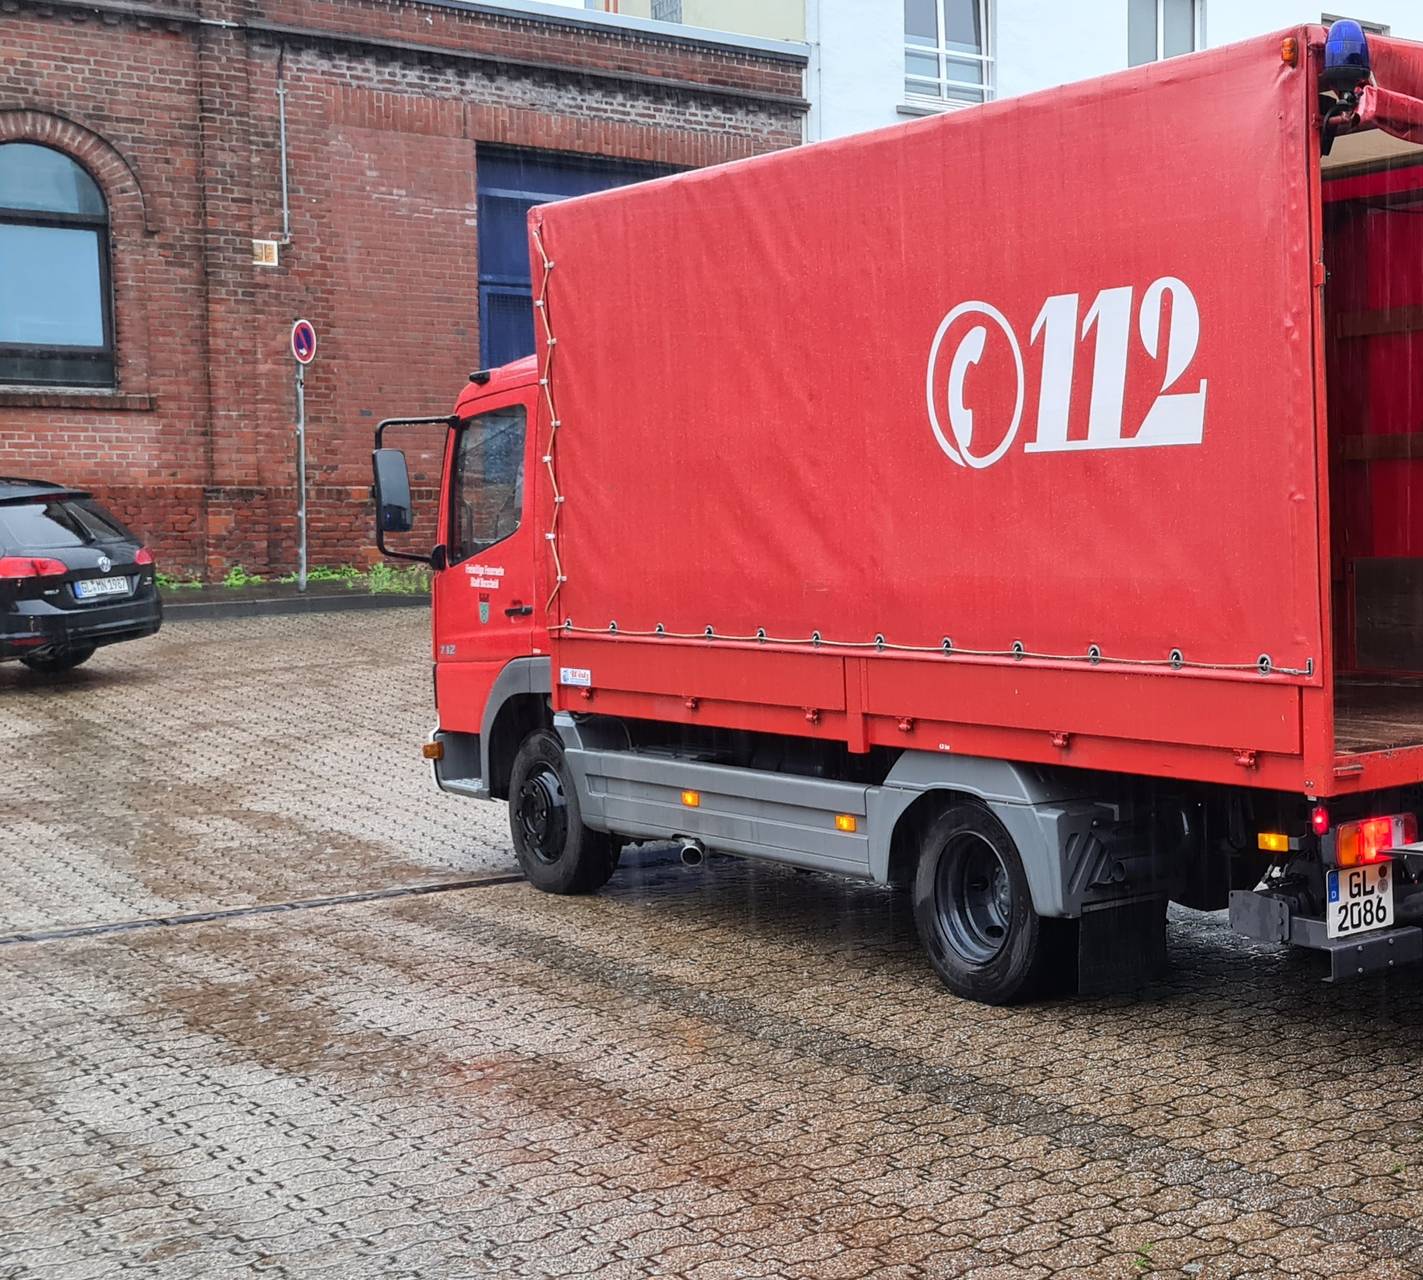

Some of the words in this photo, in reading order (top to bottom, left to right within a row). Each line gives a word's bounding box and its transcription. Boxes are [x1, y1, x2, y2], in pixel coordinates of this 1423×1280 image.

[1024, 276, 1208, 453] 112
[1349, 870, 1375, 898] GL
[1338, 896, 1387, 932] 2086
